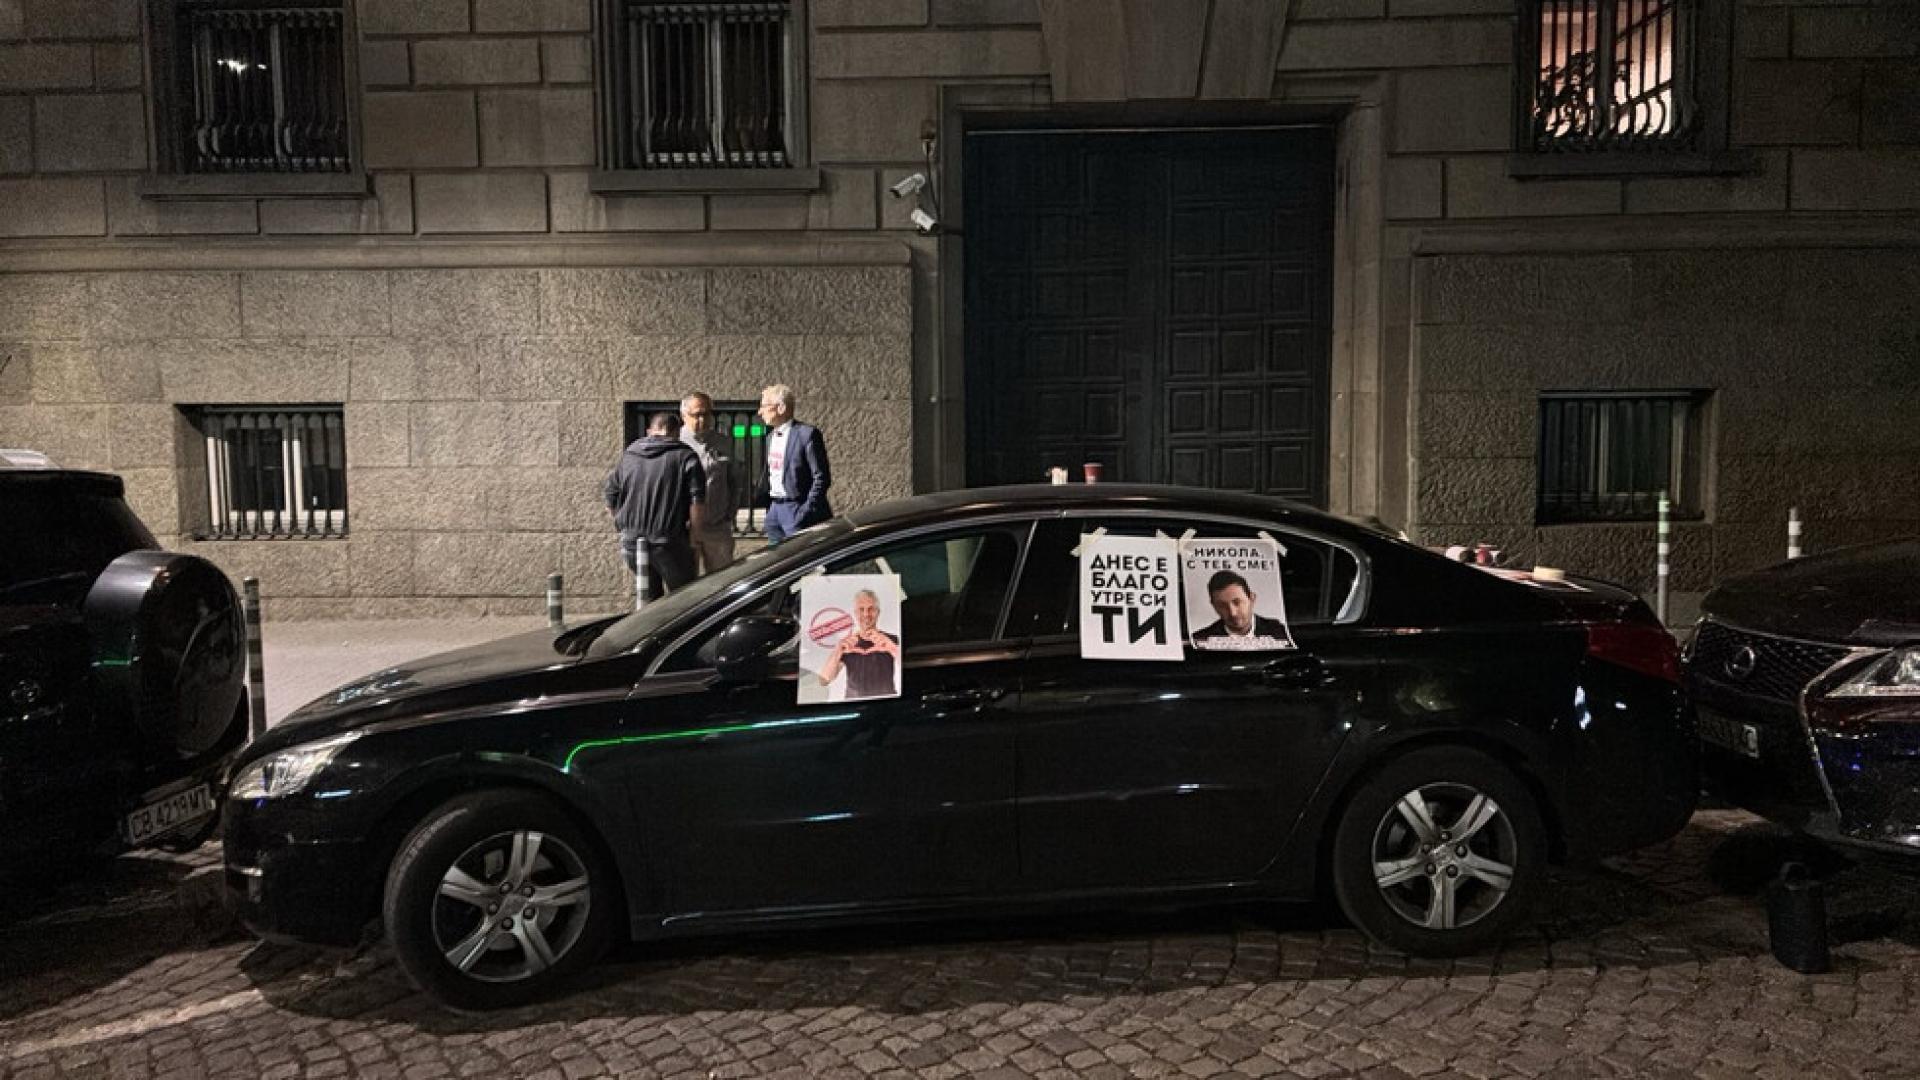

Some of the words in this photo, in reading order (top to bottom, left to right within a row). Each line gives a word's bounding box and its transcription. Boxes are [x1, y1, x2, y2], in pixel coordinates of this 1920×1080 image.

[1090, 554, 1150, 571] ДНЕС
[1157, 557, 1168, 573] Е
[1187, 560, 1196, 569] С
[1203, 560, 1231, 570] ТЕБ
[1092, 571, 1168, 591] БЛАГО
[1091, 590, 1135, 605] УТРЕ
[1140, 593, 1167, 607] СИ
[1091, 605, 1167, 645] ТИ
